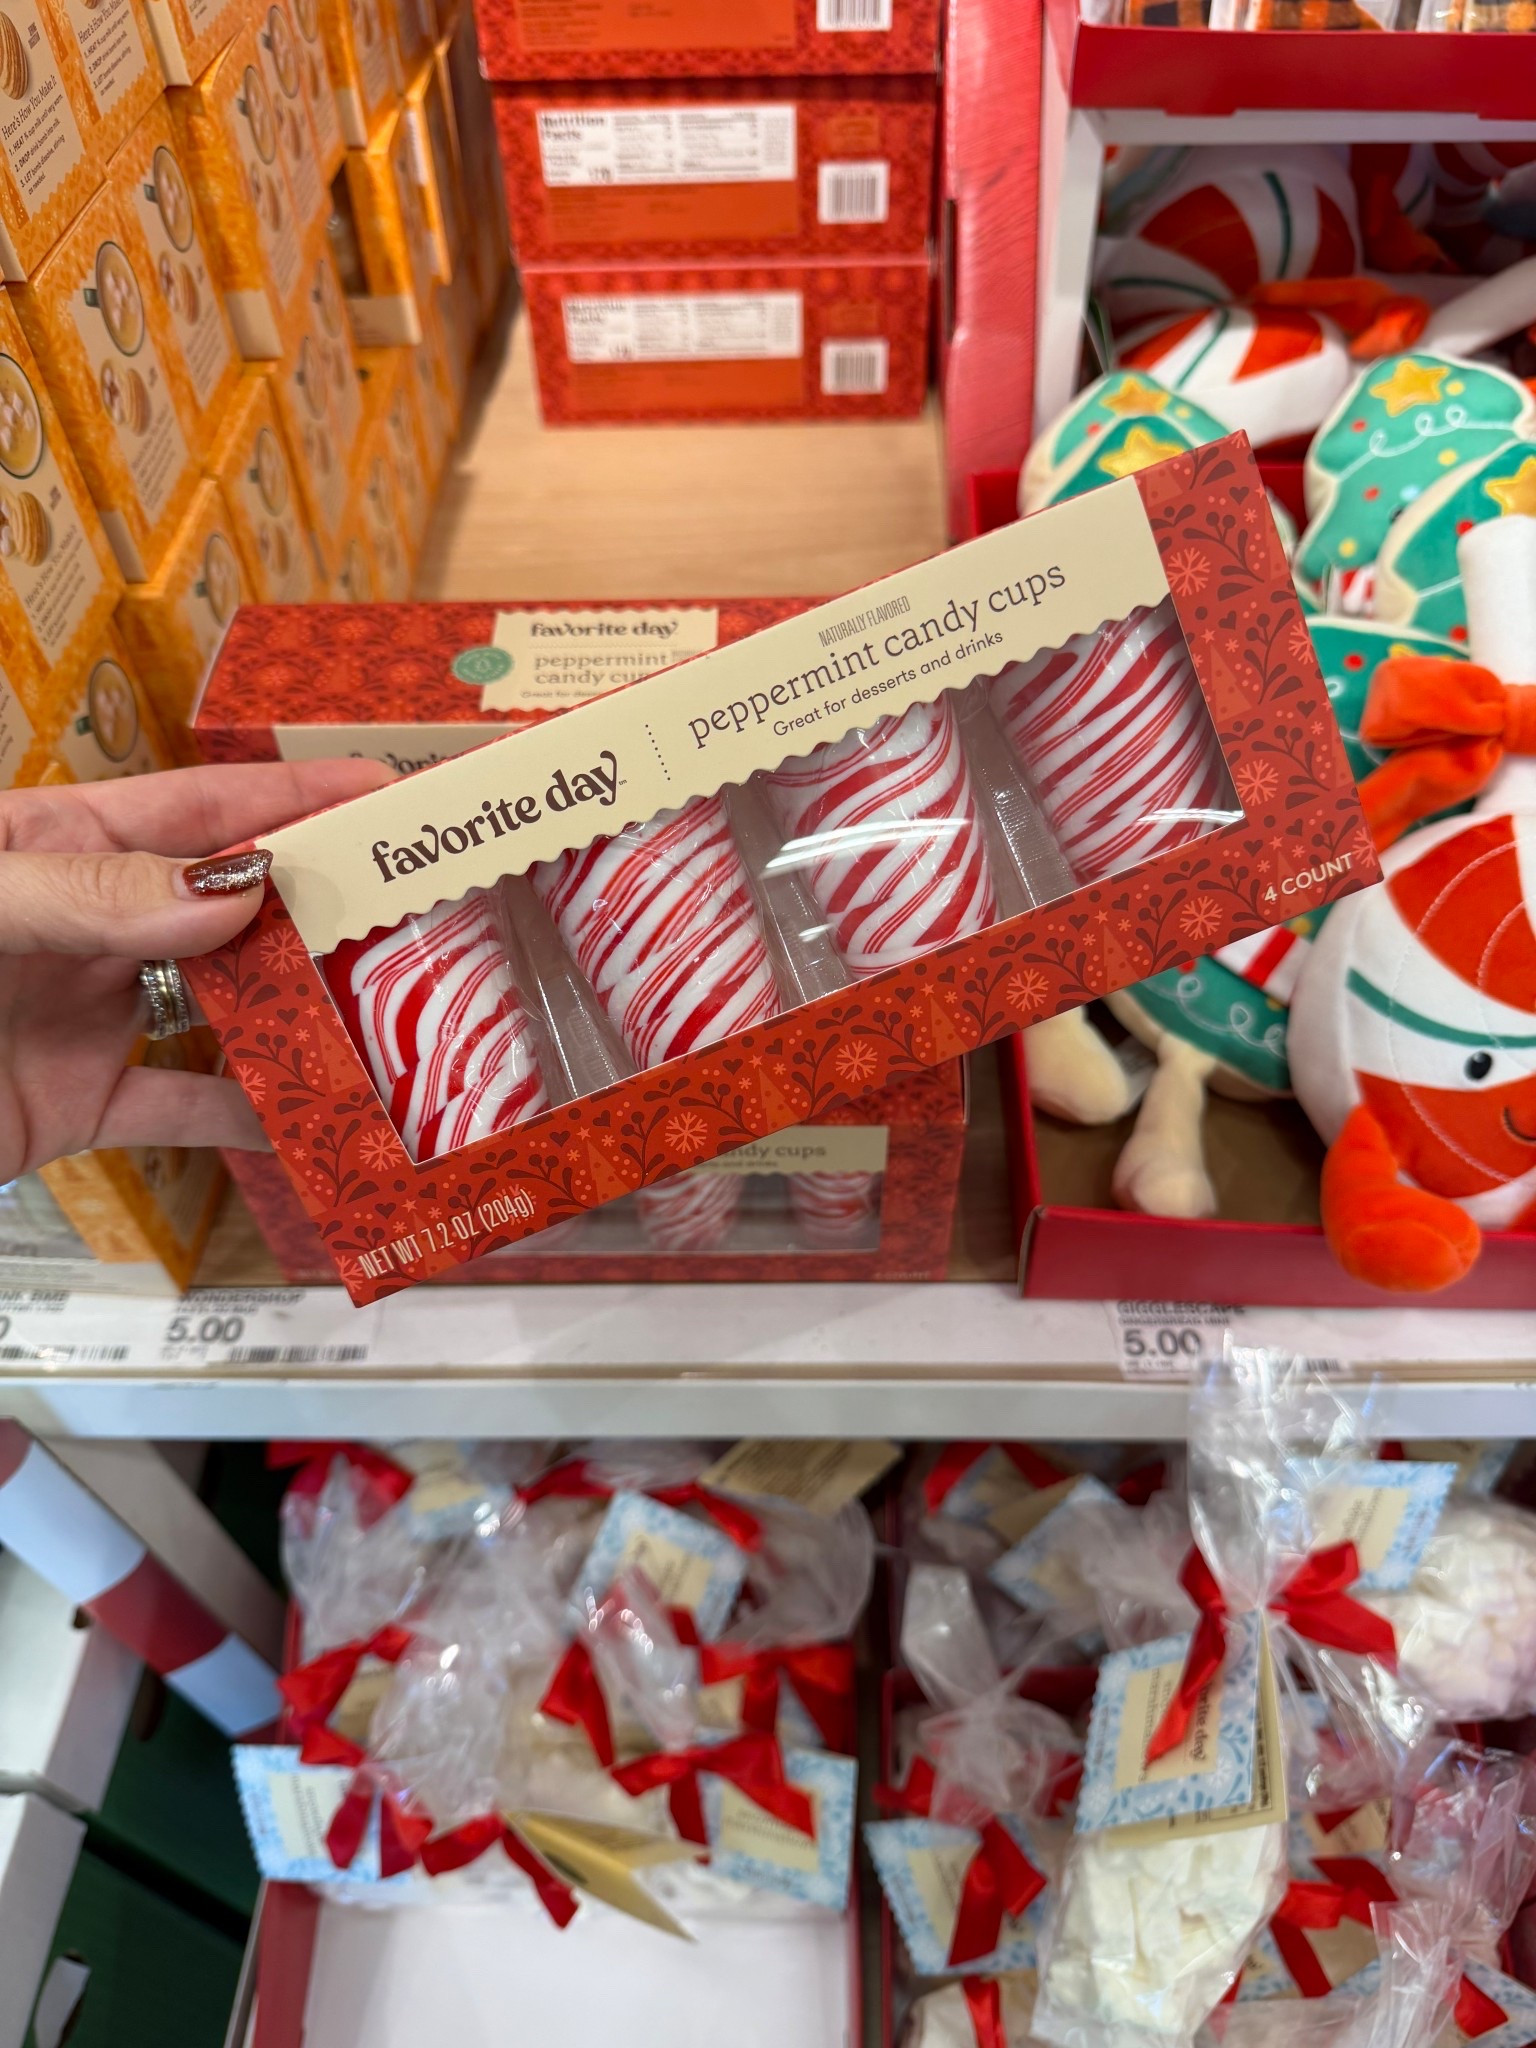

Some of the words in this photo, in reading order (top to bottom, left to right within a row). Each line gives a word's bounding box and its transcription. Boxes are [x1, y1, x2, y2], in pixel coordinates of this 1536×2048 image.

[2, 115, 21, 140] Here's
[18, 104, 32, 124] How
[29, 93, 41, 110] You
[38, 81, 53, 101] Make
[530, 622, 628, 637] favorite
[632, 621, 680, 639] day
[818, 612, 867, 648] NATURALLY
[866, 595, 911, 627] FLAVORED
[534, 652, 668, 671] peppermint
[534, 668, 605, 687] candy
[688, 642, 880, 749] peppermint
[884, 599, 980, 658] candy
[988, 565, 1067, 613] cups
[773, 707, 822, 738] Great
[823, 696, 846, 716] for
[850, 668, 917, 704] desserts
[920, 650, 952, 676] and
[955, 630, 1004, 661] drinks
[371, 800, 542, 883] favorite
[545, 750, 618, 812] day
[1264, 886, 1278, 902] 4
[1281, 852, 1352, 895] COUNT
[775, 1146, 827, 1161] cups
[357, 1245, 395, 1280] NET
[390, 1234, 424, 1265] WT
[420, 1222, 455, 1253] 7.2
[451, 1211, 481, 1240] OZ
[477, 1188, 536, 1232] (204g)
[166, 1317, 243, 1343] 5.00
[1124, 1328, 1203, 1356] 5.00
